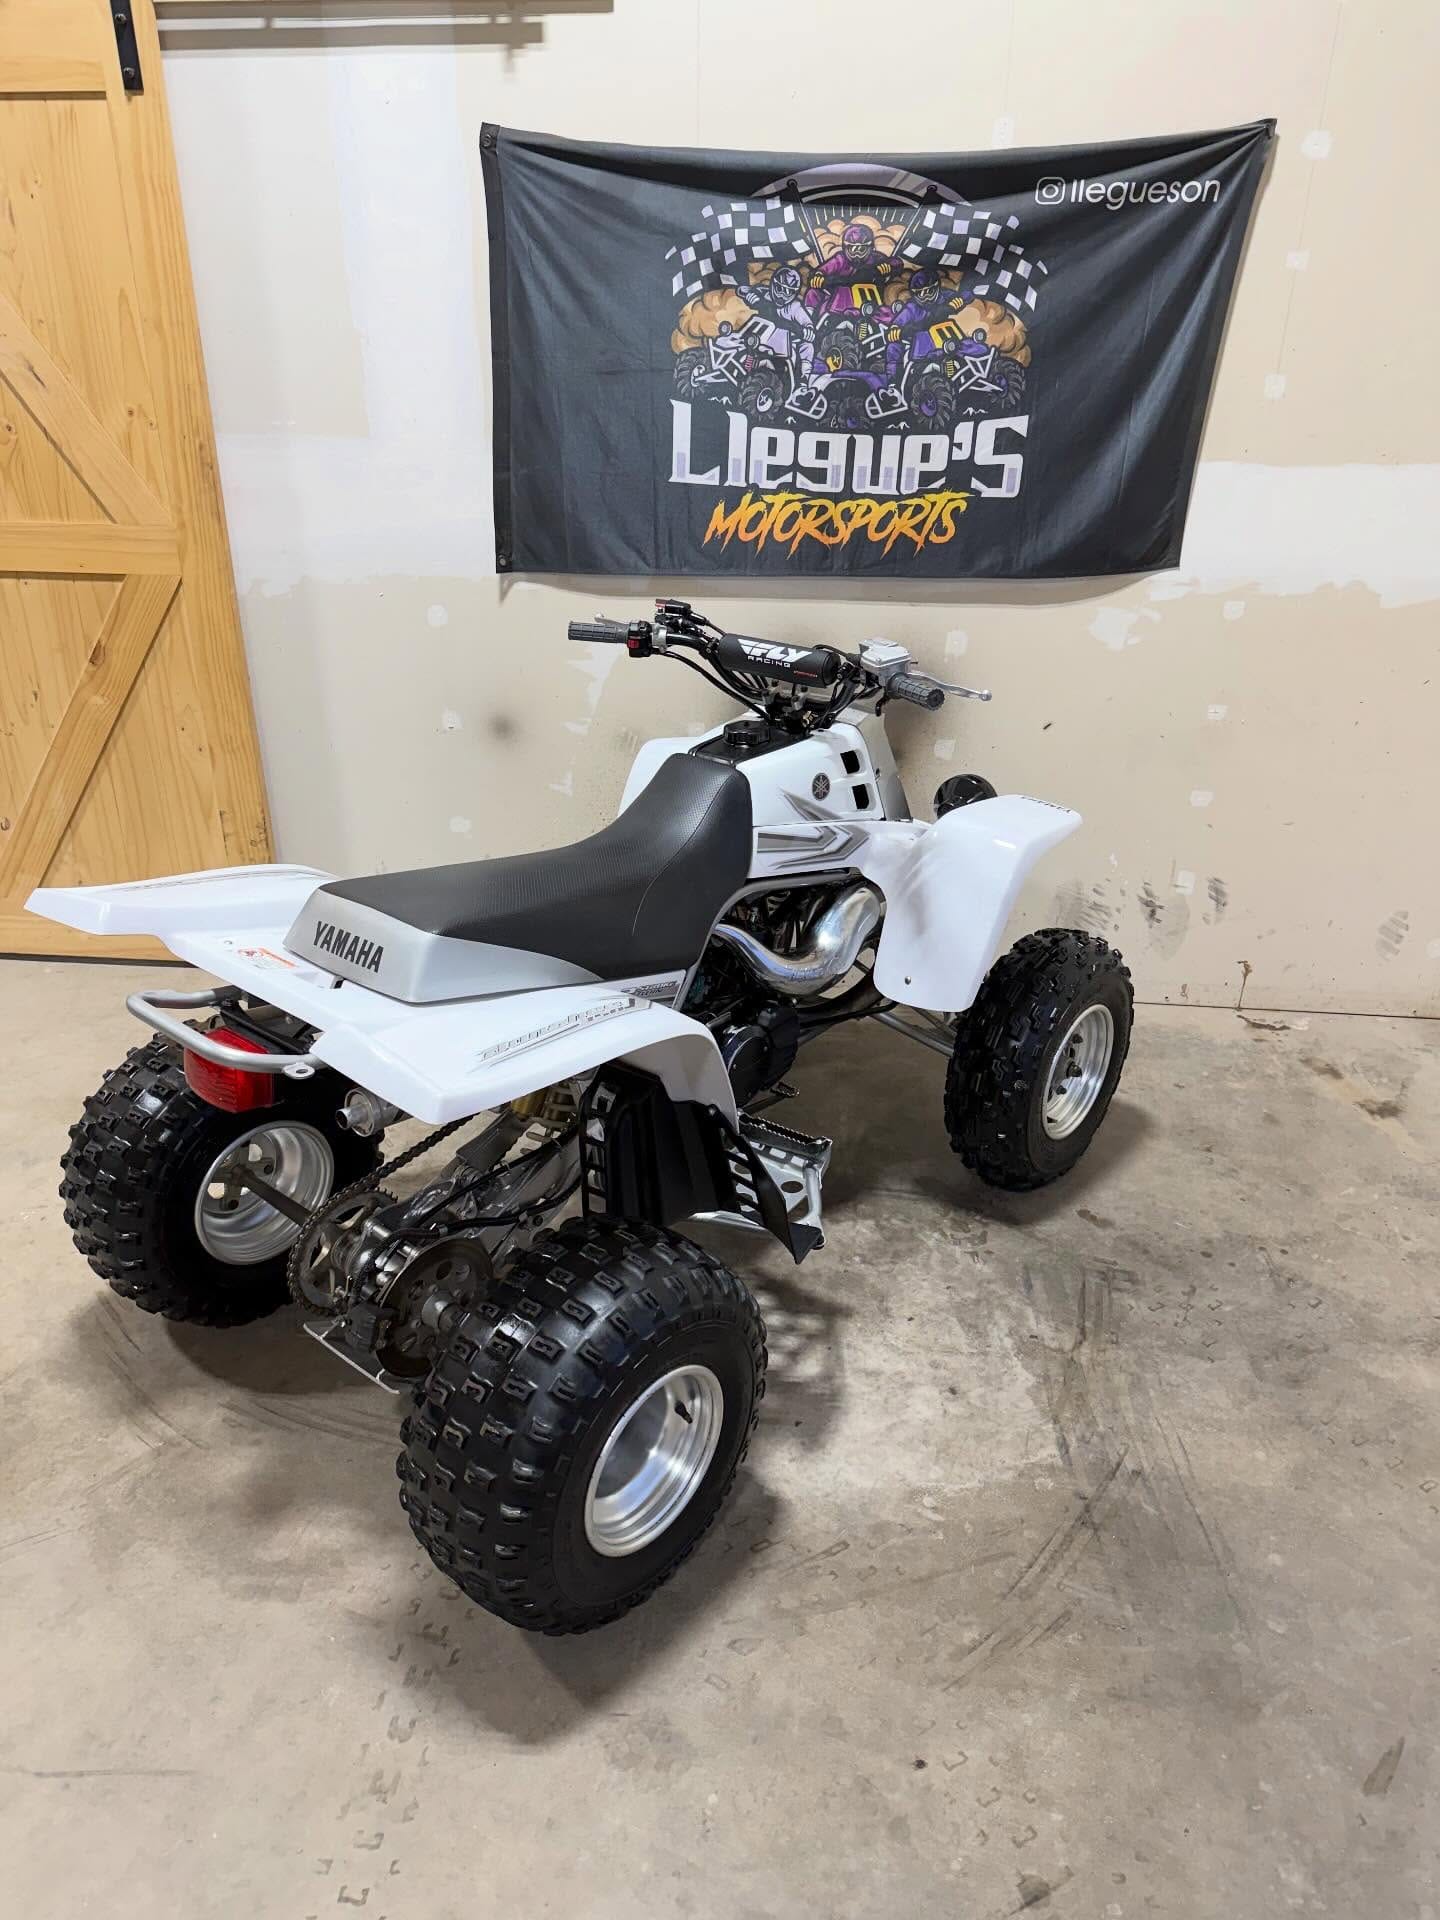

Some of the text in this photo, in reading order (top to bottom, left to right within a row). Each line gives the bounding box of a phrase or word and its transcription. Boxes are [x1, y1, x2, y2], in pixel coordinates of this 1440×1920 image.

[1070, 179, 1221, 211] llegueson
[702, 490, 975, 559] MOTORSPORTS
[738, 639, 812, 662] FLY
[747, 655, 791, 668] RACING
[313, 921, 385, 973] YAMAHA
